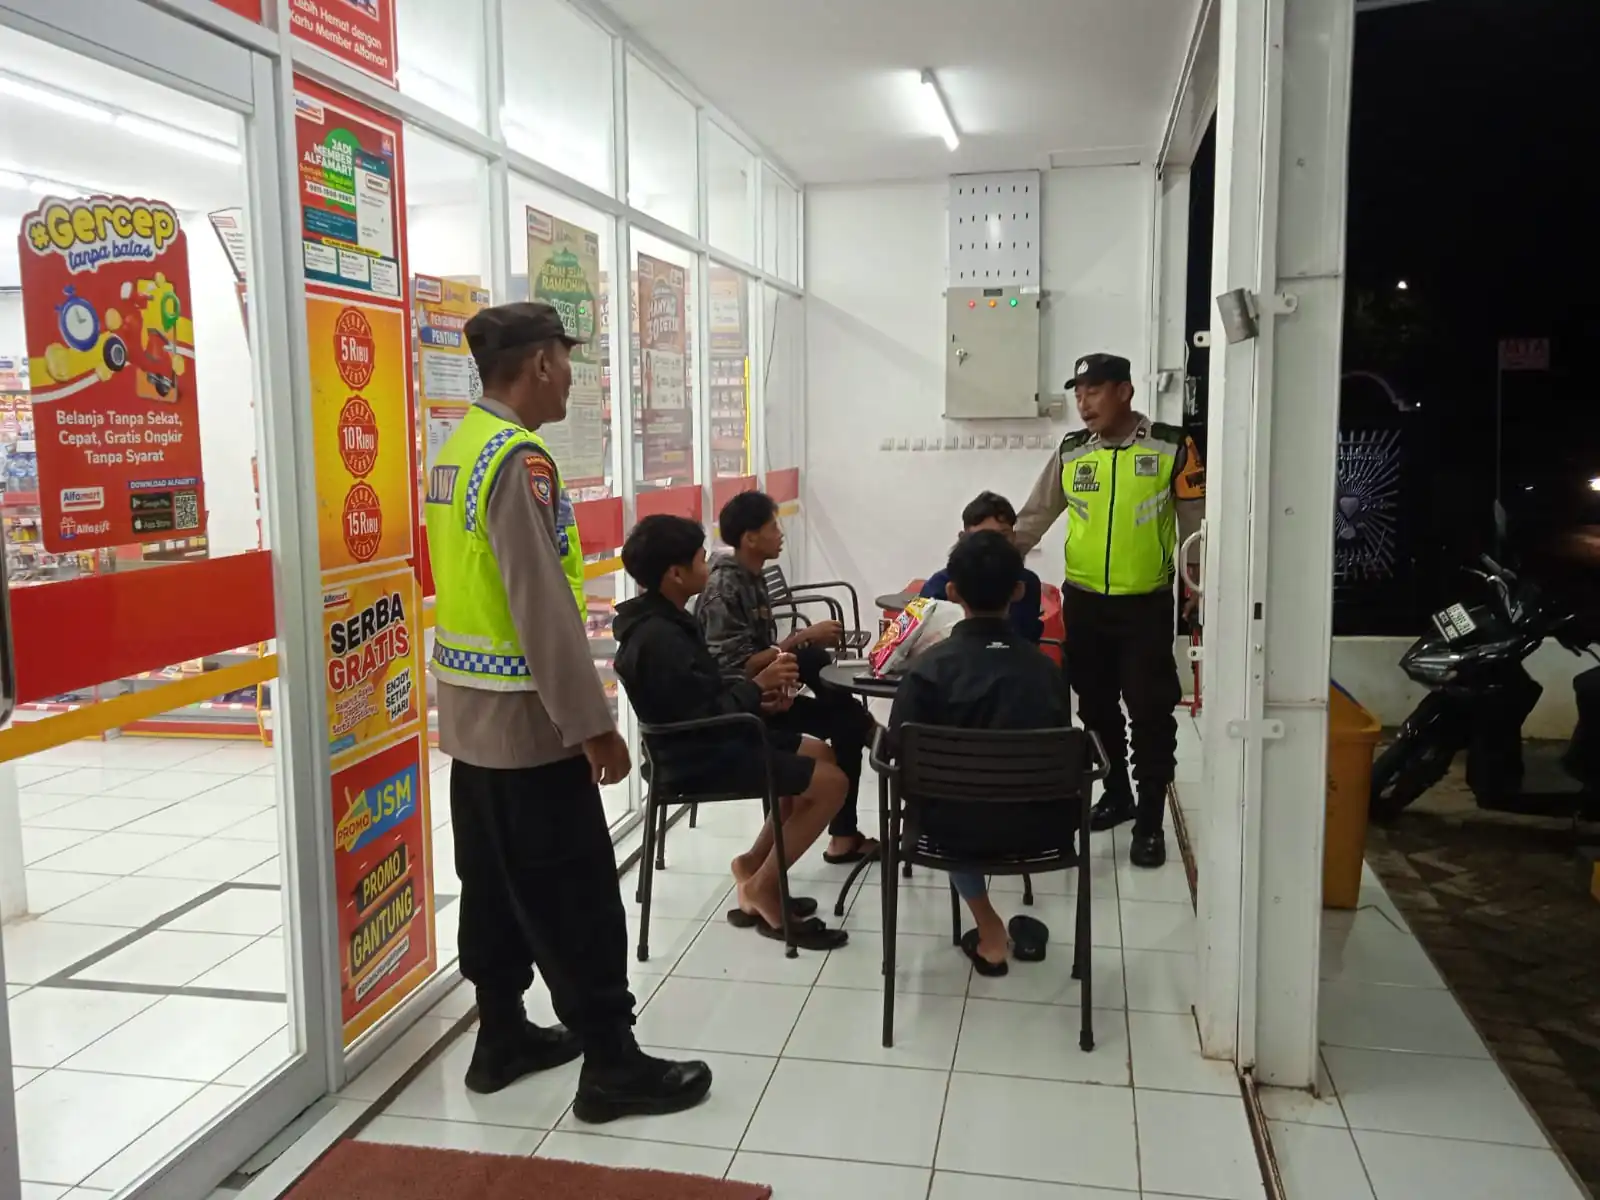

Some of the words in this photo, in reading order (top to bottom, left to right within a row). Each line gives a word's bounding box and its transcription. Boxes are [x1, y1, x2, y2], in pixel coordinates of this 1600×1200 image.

[320, 6, 349, 32] Hemat
[351, 24, 382, 49] dengan
[315, 22, 352, 50] Member
[354, 42, 387, 68] Alfamart
[303, 150, 352, 177] ALFAMART
[313, 142, 352, 166] MEMBER
[29, 204, 174, 250] #Gercep
[69, 244, 109, 269] tanpa
[341, 335, 348, 361] 5
[56, 410, 104, 428] Belanja
[107, 411, 144, 428] Tanpa
[147, 411, 183, 427] Sekat,
[58, 430, 101, 447] Cepat,
[105, 430, 141, 445] Gratis
[144, 430, 183, 446] Ongkir
[342, 426, 355, 450] 10
[84, 450, 123, 466] Tanpa
[126, 449, 164, 466] Syarat
[63, 490, 101, 502] Alfamart
[76, 520, 111, 534] Alfagift
[346, 512, 359, 536] 15
[330, 593, 405, 654] SERBA
[328, 625, 409, 690] GRATIS
[386, 669, 410, 695] ENJOY
[386, 682, 411, 708] SETIAP
[371, 774, 411, 825] JSM
[337, 813, 370, 842] PROMO
[363, 850, 401, 905] PROMO
[353, 886, 413, 968] GANTUNG
